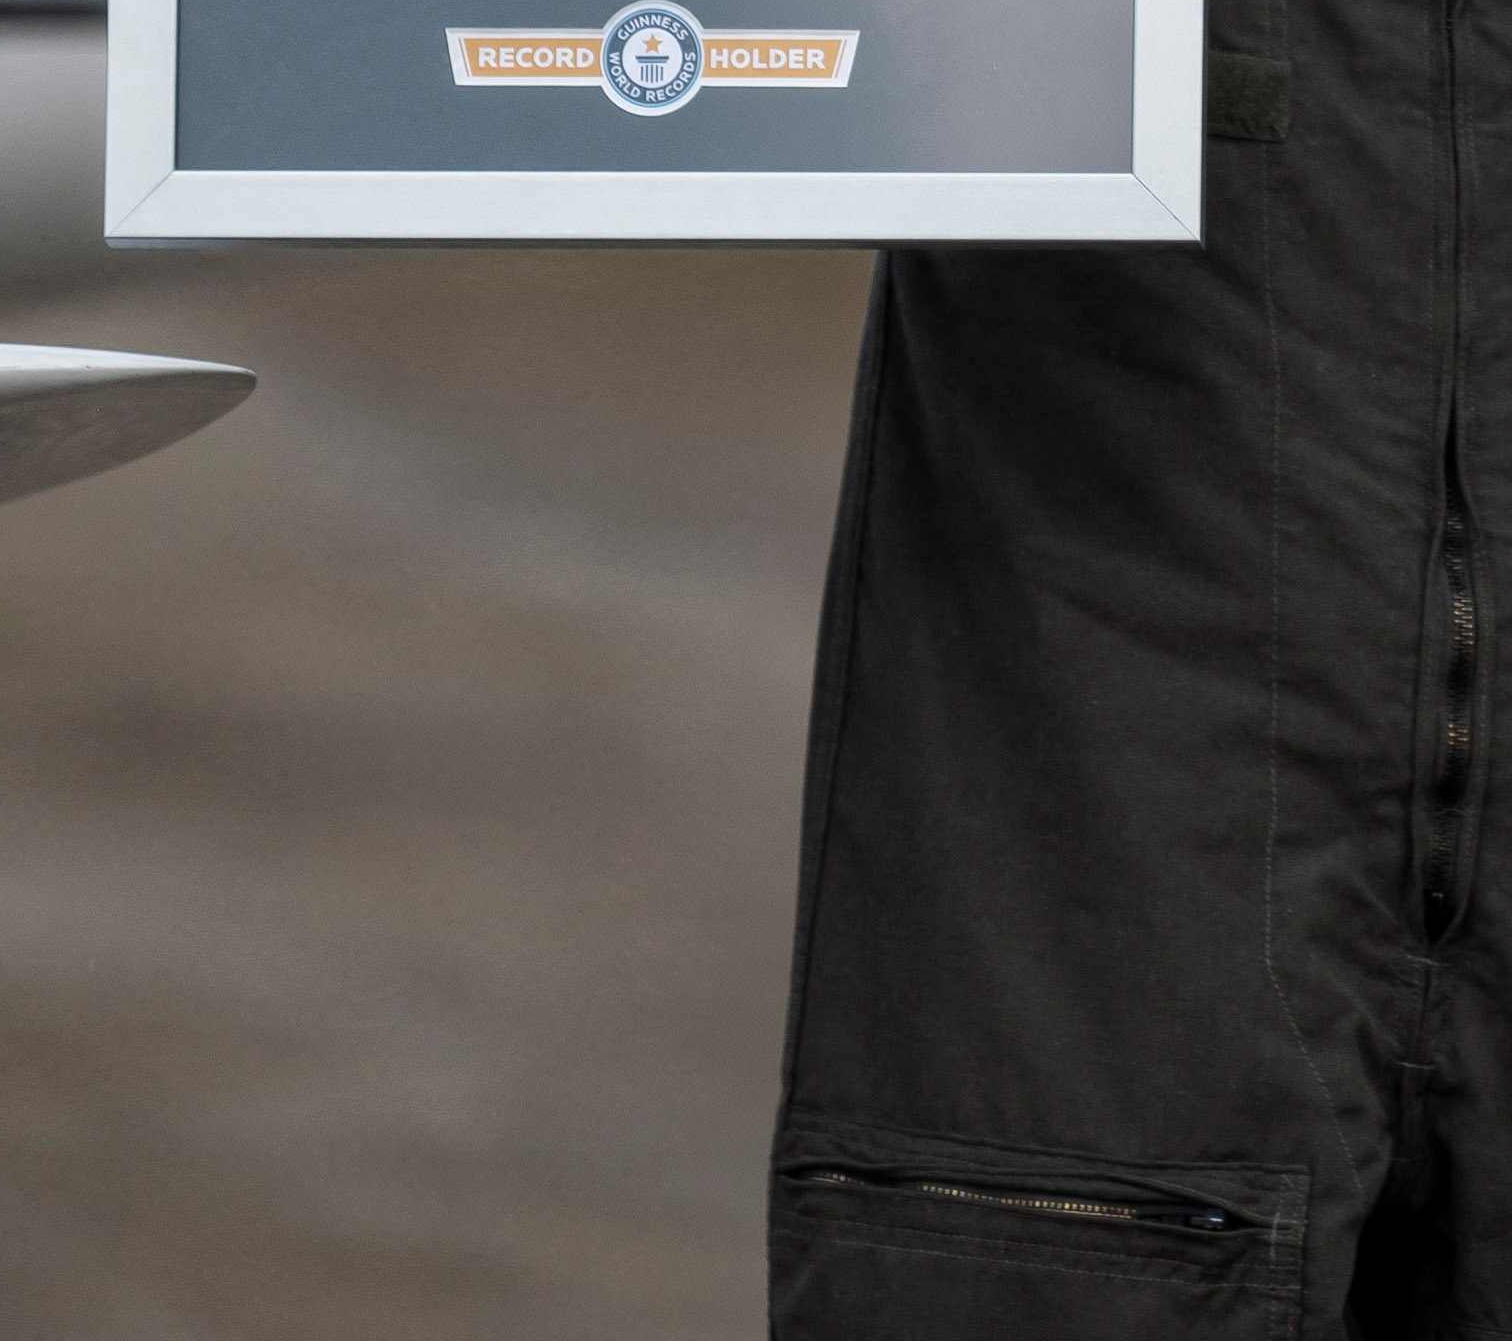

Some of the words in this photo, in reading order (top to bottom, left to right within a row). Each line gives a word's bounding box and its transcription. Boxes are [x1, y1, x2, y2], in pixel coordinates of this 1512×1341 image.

[617, 15, 688, 41] GUINNESS
[478, 47, 593, 69] RECORD
[710, 48, 826, 70] HOLDER
[610, 52, 640, 98] WORLD
[645, 52, 696, 102] RECORDS
